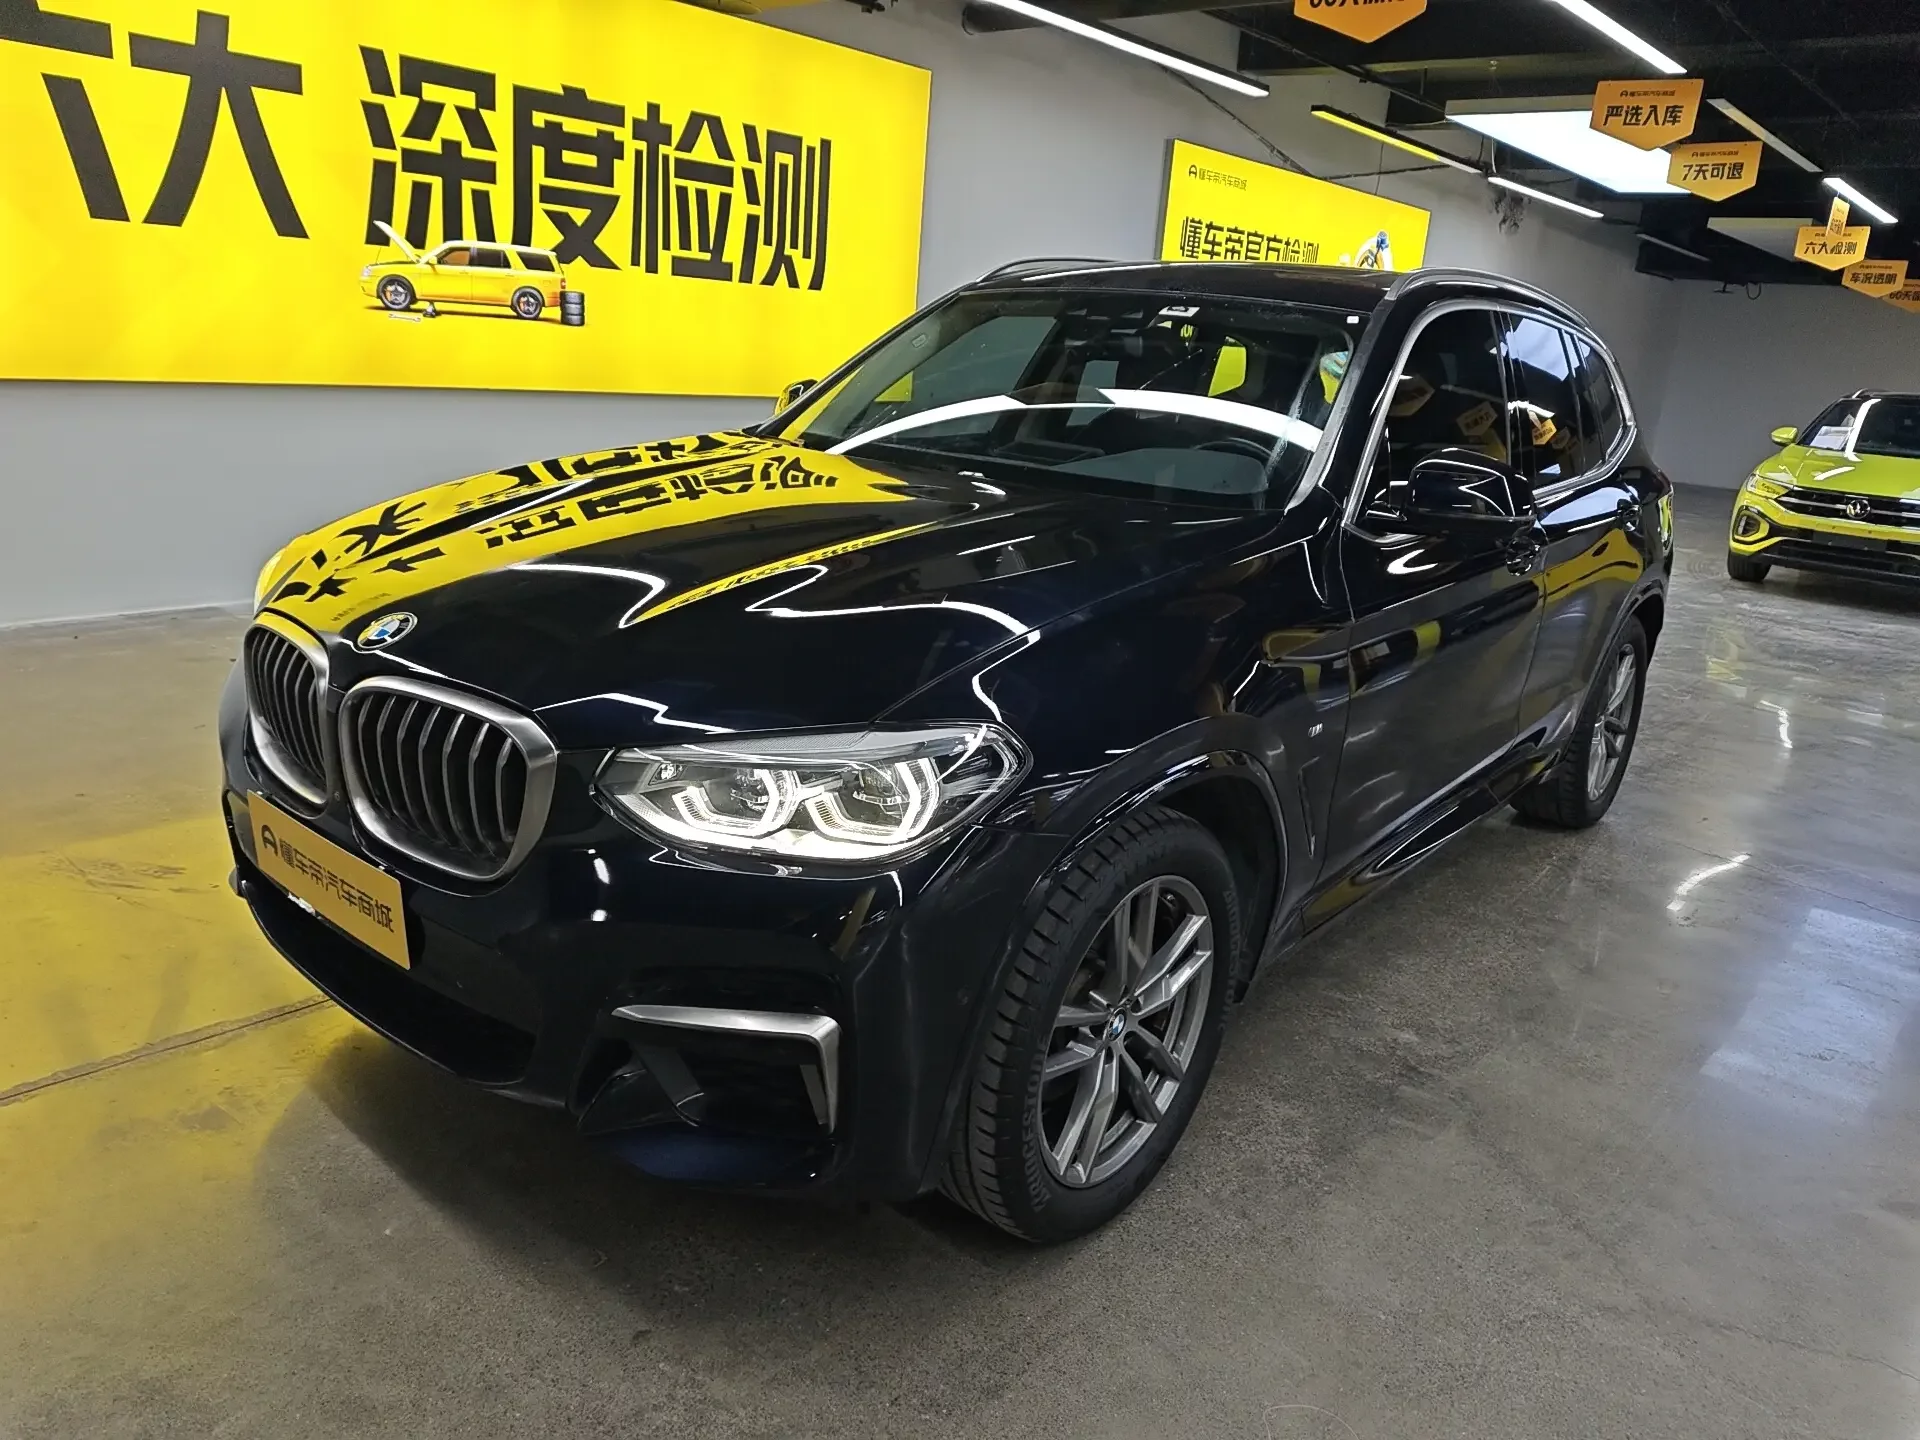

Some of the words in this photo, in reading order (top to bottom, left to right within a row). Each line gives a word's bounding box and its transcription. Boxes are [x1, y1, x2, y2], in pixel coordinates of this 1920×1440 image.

[1603, 104, 1684, 126] 严选入库
[359, 44, 832, 291] 深度检测
[1682, 162, 1745, 181] 7天可退
[1180, 216, 1319, 263] 懂车帝官方检测
[1804, 241, 1857, 255] 六大检测
[1850, 272, 1898, 285] 车况透明
[279, 838, 395, 933] 懂车帝汽车商城
